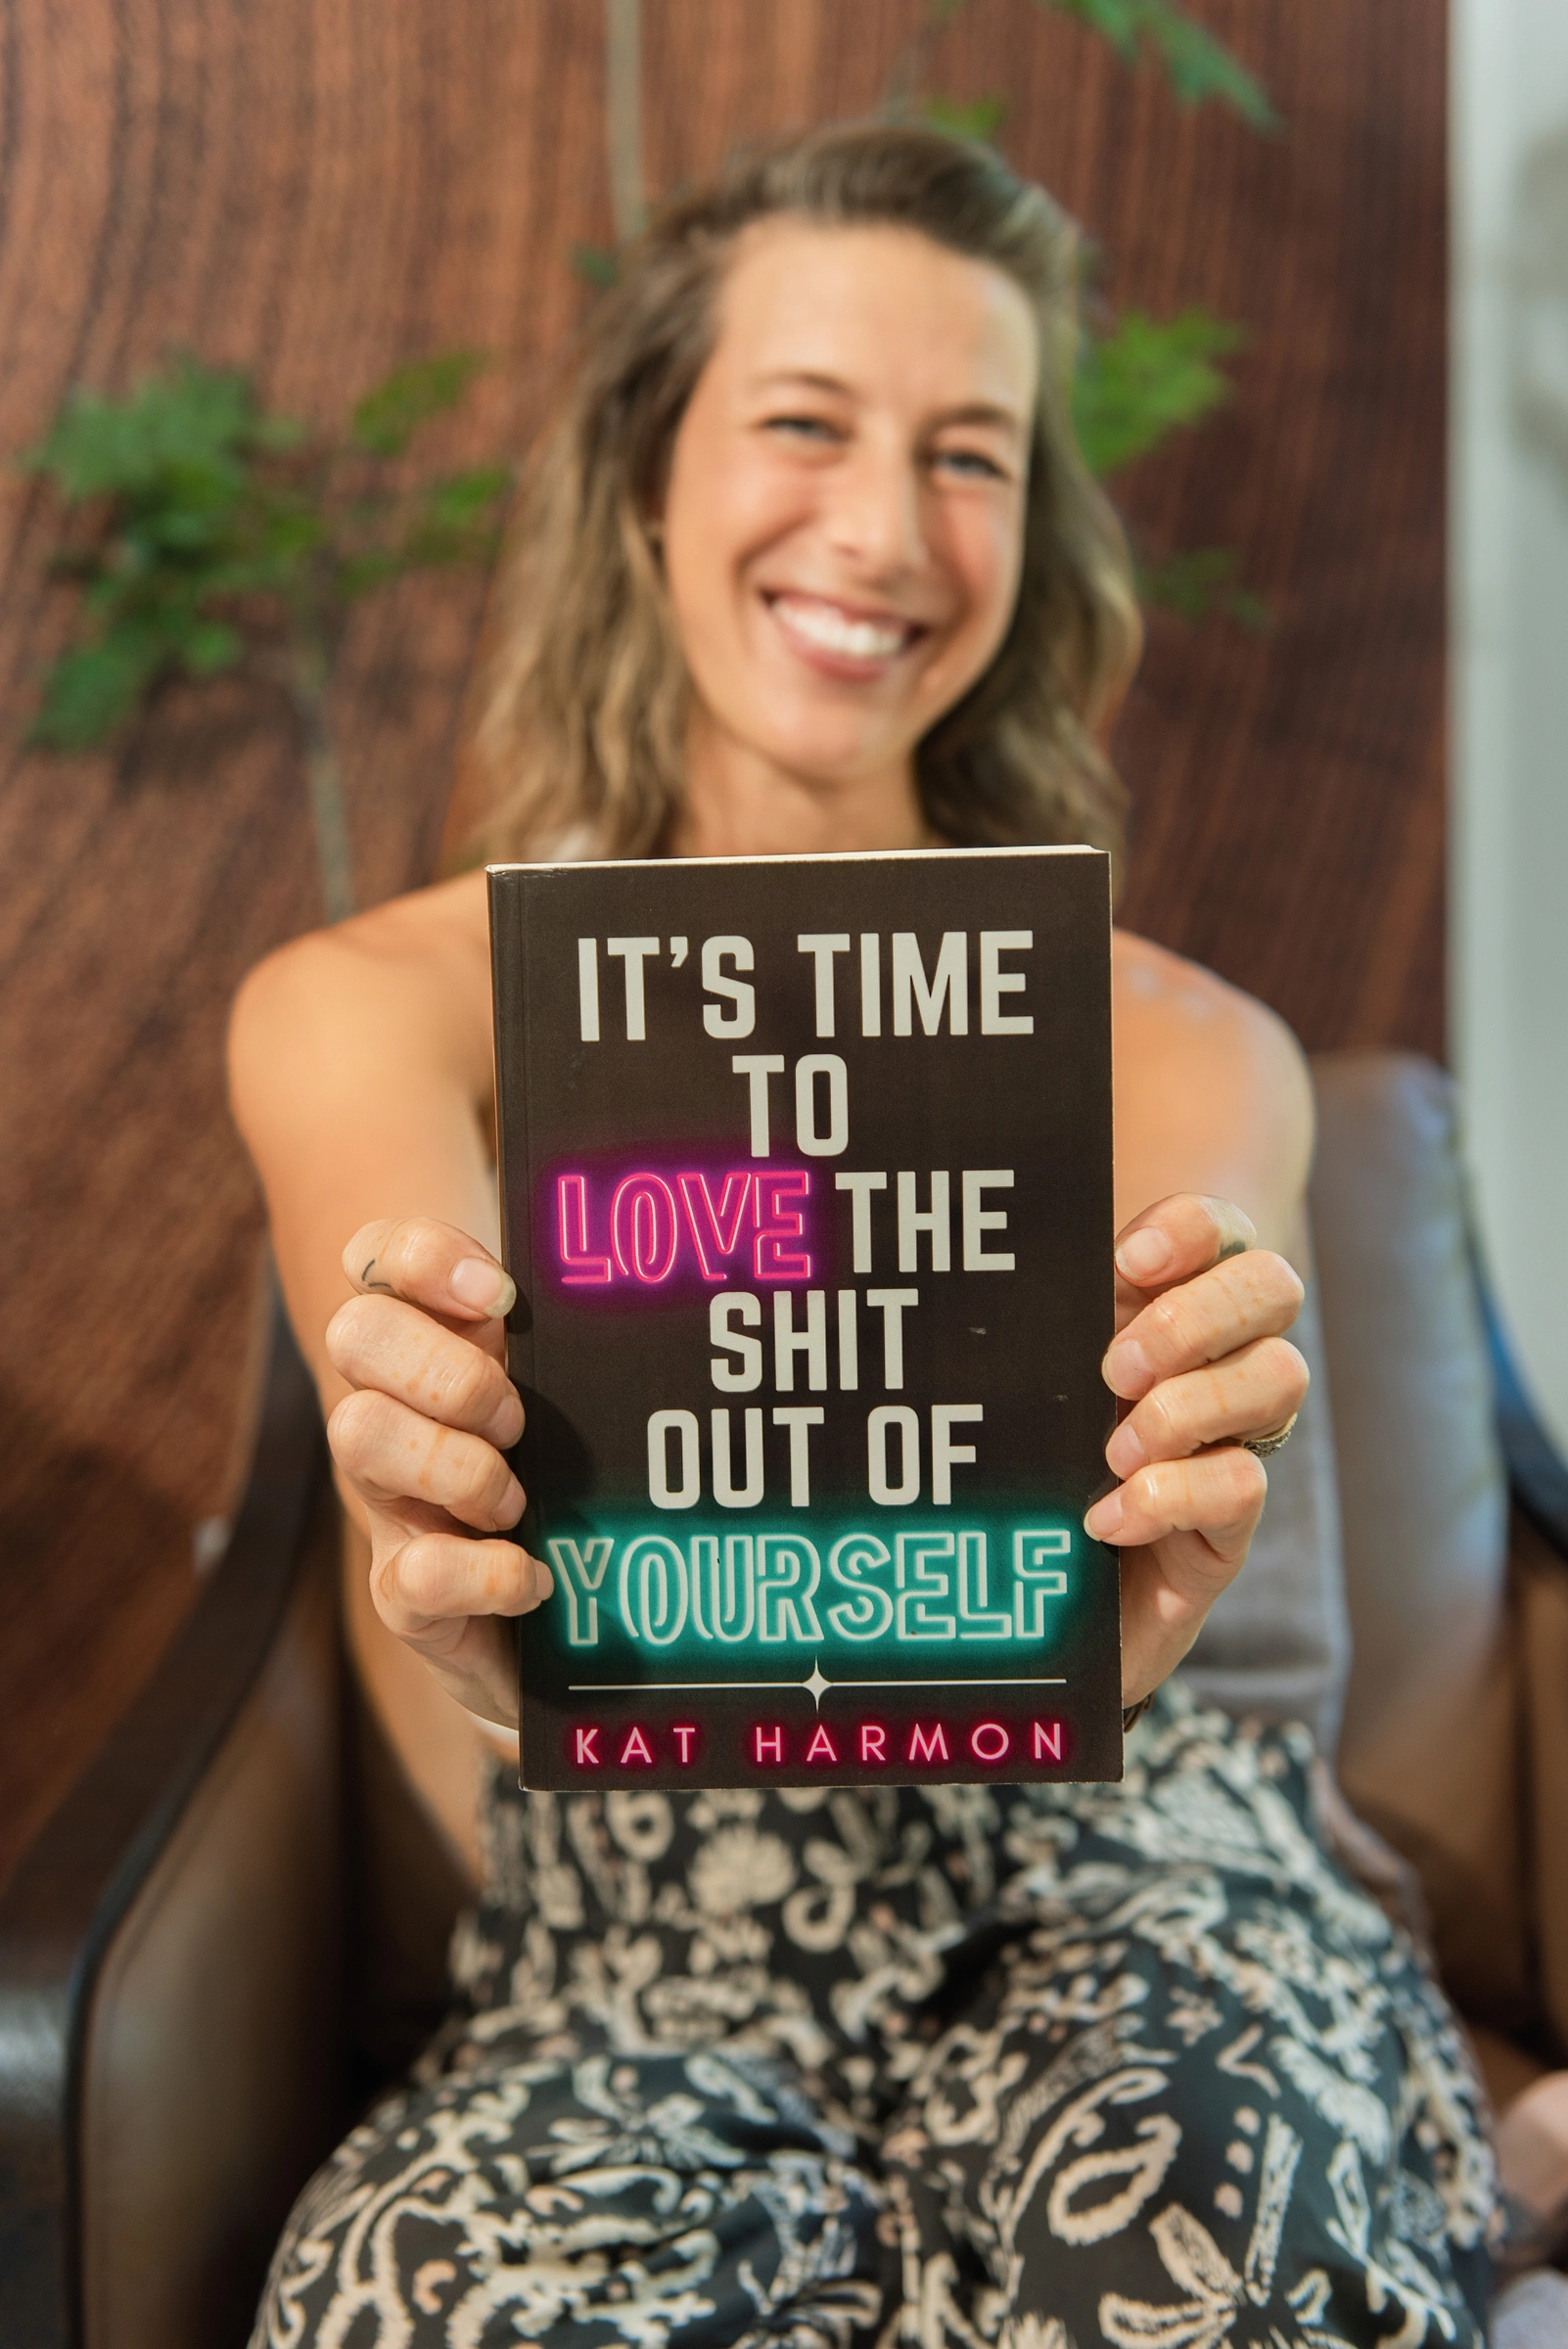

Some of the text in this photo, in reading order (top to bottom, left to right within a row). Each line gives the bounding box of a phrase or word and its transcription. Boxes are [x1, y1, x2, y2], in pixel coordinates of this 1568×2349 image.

[577, 930, 1035, 1041] IT'S TIME
[732, 1053, 849, 1158] TO
[557, 1170, 1016, 1284] LOVE THE
[709, 1288, 919, 1393] SHIT
[647, 1404, 984, 1509] OUT OF
[547, 1530, 1072, 1646] YOURSELF
[576, 1722, 1062, 1765] KAT HARMON
